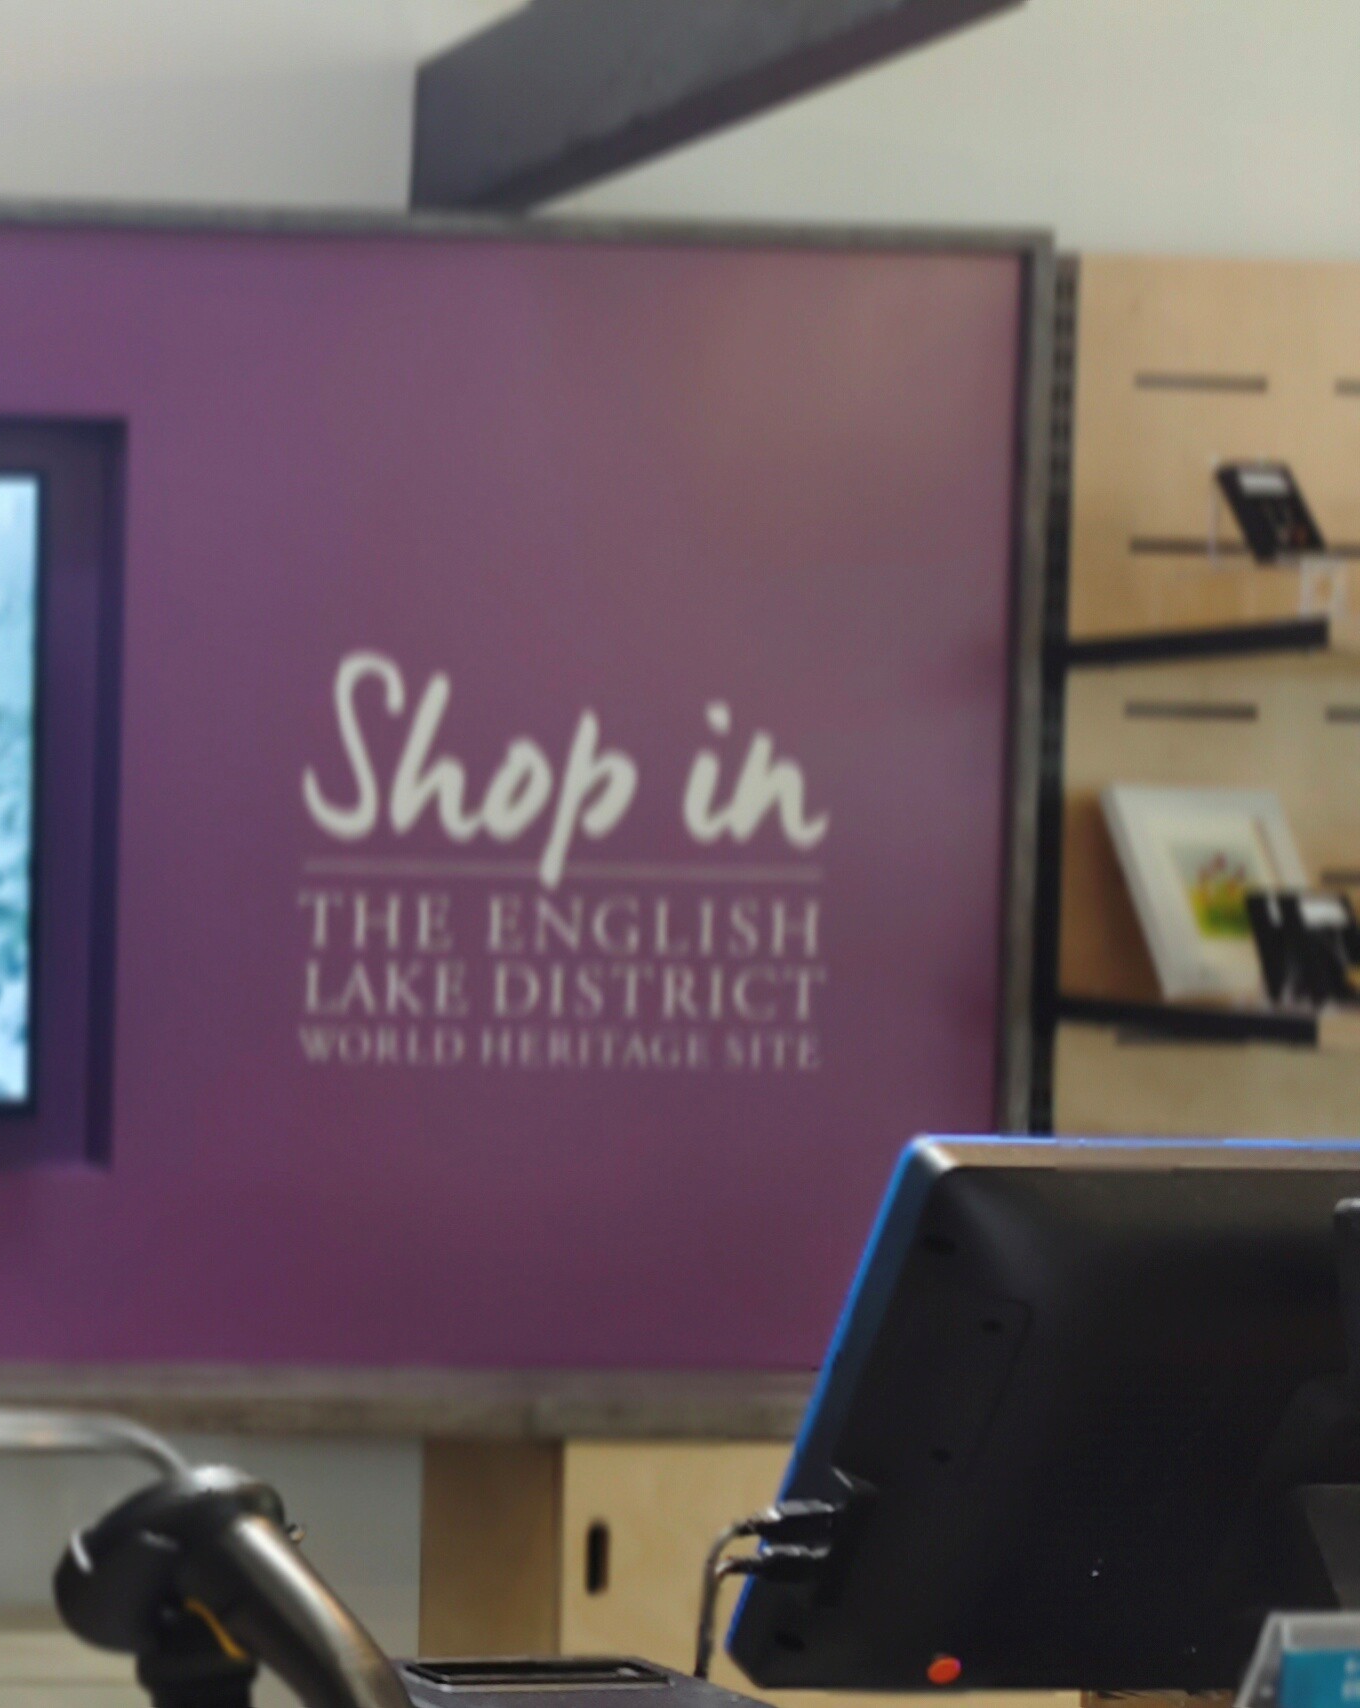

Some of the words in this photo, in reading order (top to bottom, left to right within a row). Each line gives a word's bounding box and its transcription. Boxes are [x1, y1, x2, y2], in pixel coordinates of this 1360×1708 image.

[302, 649, 638, 890] Shop
[682, 699, 831, 850] in
[298, 891, 454, 952] THE
[486, 894, 821, 957] ENGLISH
[304, 959, 470, 1017] LAKE
[492, 962, 826, 1022] DISTRICT
[299, 1024, 467, 1066] WORLD
[479, 1026, 711, 1069] HERITAGE
[723, 1030, 821, 1071] SITE
